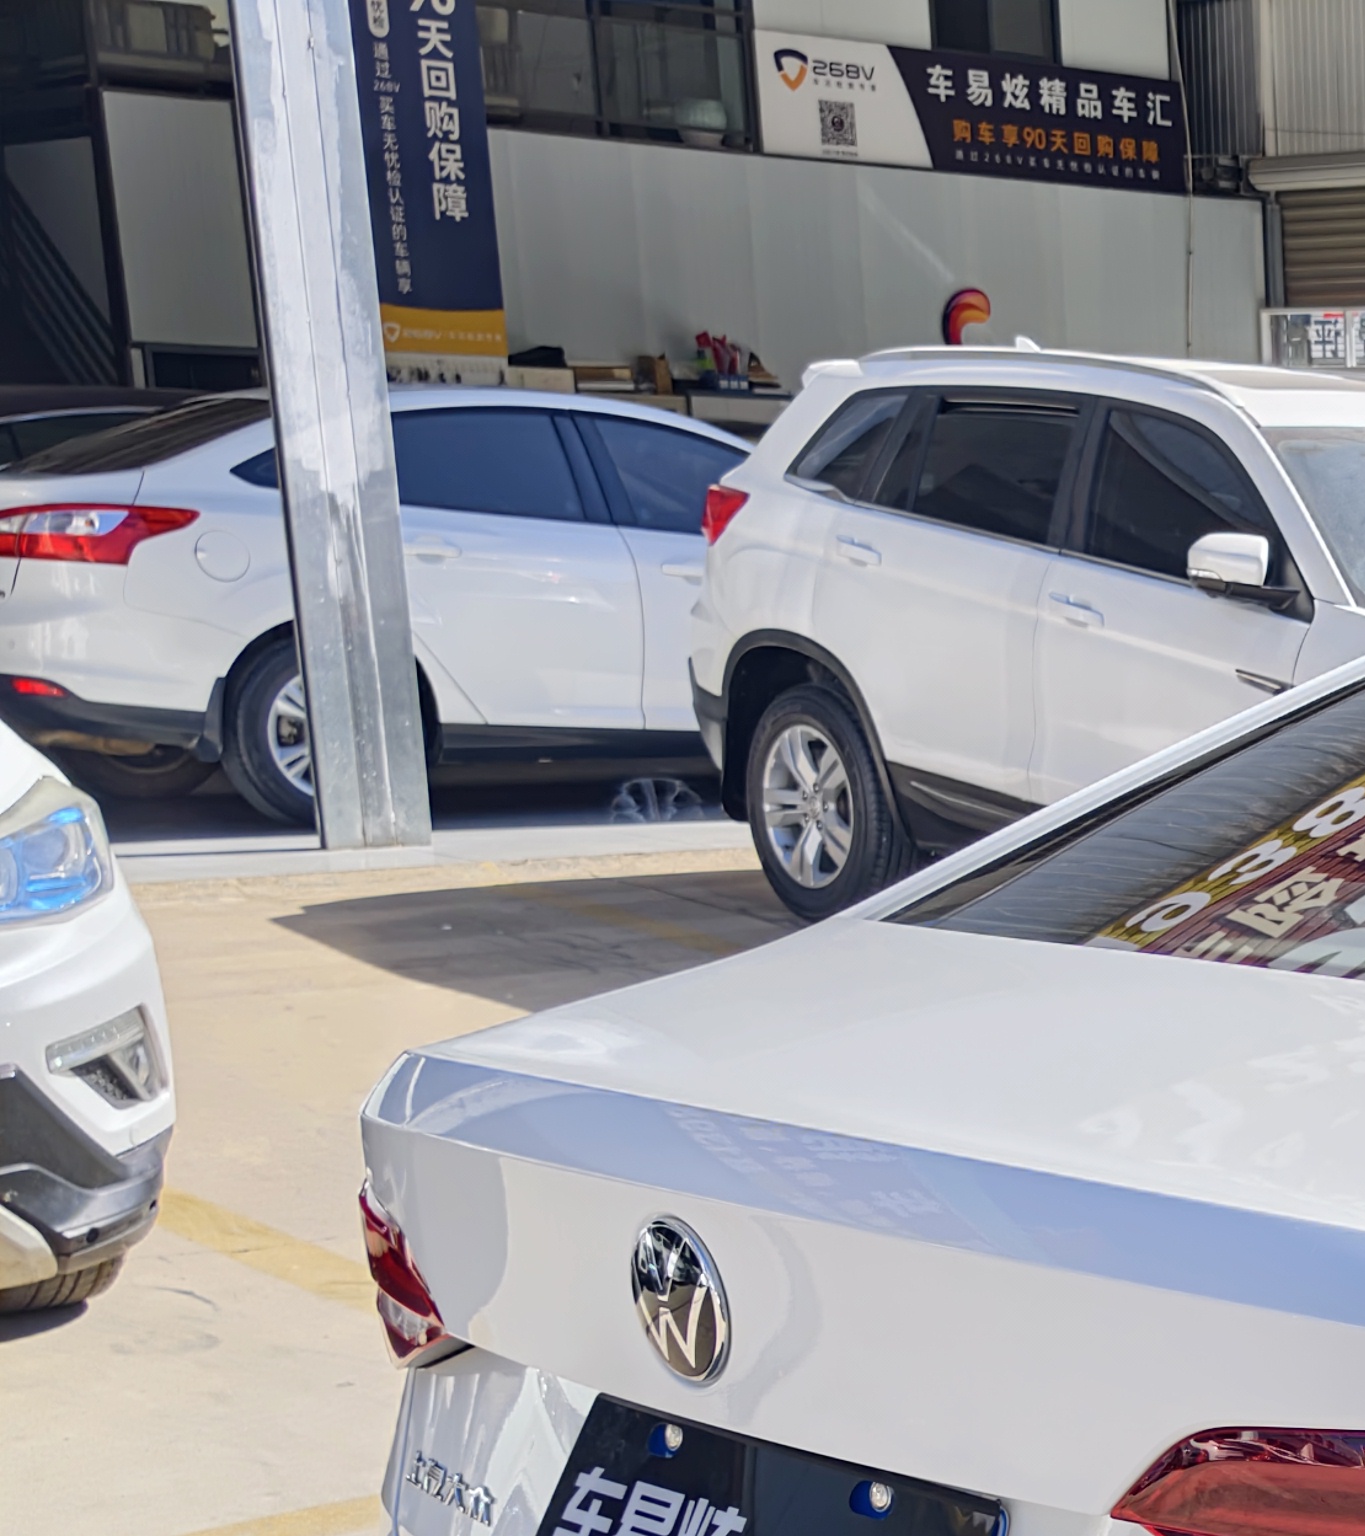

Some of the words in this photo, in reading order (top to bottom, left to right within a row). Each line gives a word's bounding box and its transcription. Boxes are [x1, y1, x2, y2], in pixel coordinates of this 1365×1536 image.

[812, 59, 875, 81] 268V
[926, 65, 1172, 127] 车易炫精品车汇
[952, 118, 1160, 164] 购车享90天回购保障
